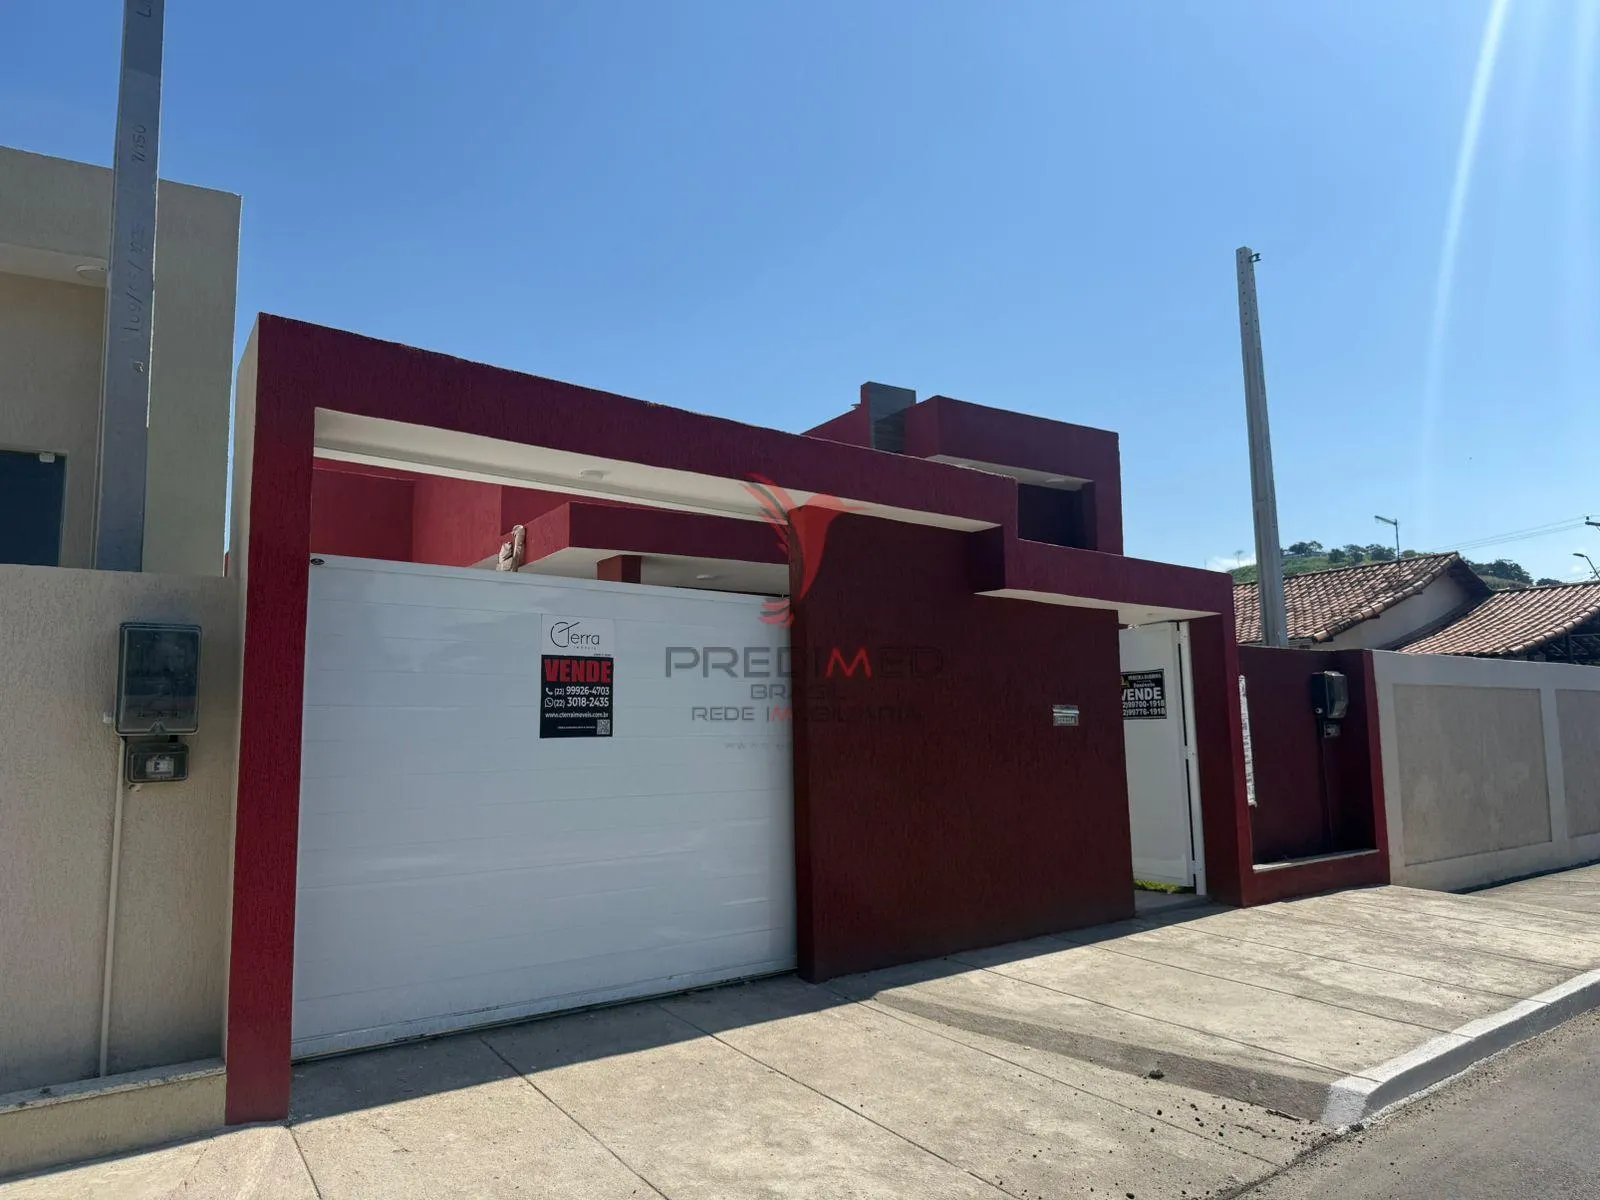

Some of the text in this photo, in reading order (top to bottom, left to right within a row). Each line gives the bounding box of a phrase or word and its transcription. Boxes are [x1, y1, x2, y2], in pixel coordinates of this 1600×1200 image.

[544, 659, 612, 683] VENDE
[554, 685, 610, 696] (22) 99926-4703
[553, 696, 610, 708] (22) 3018-2435
